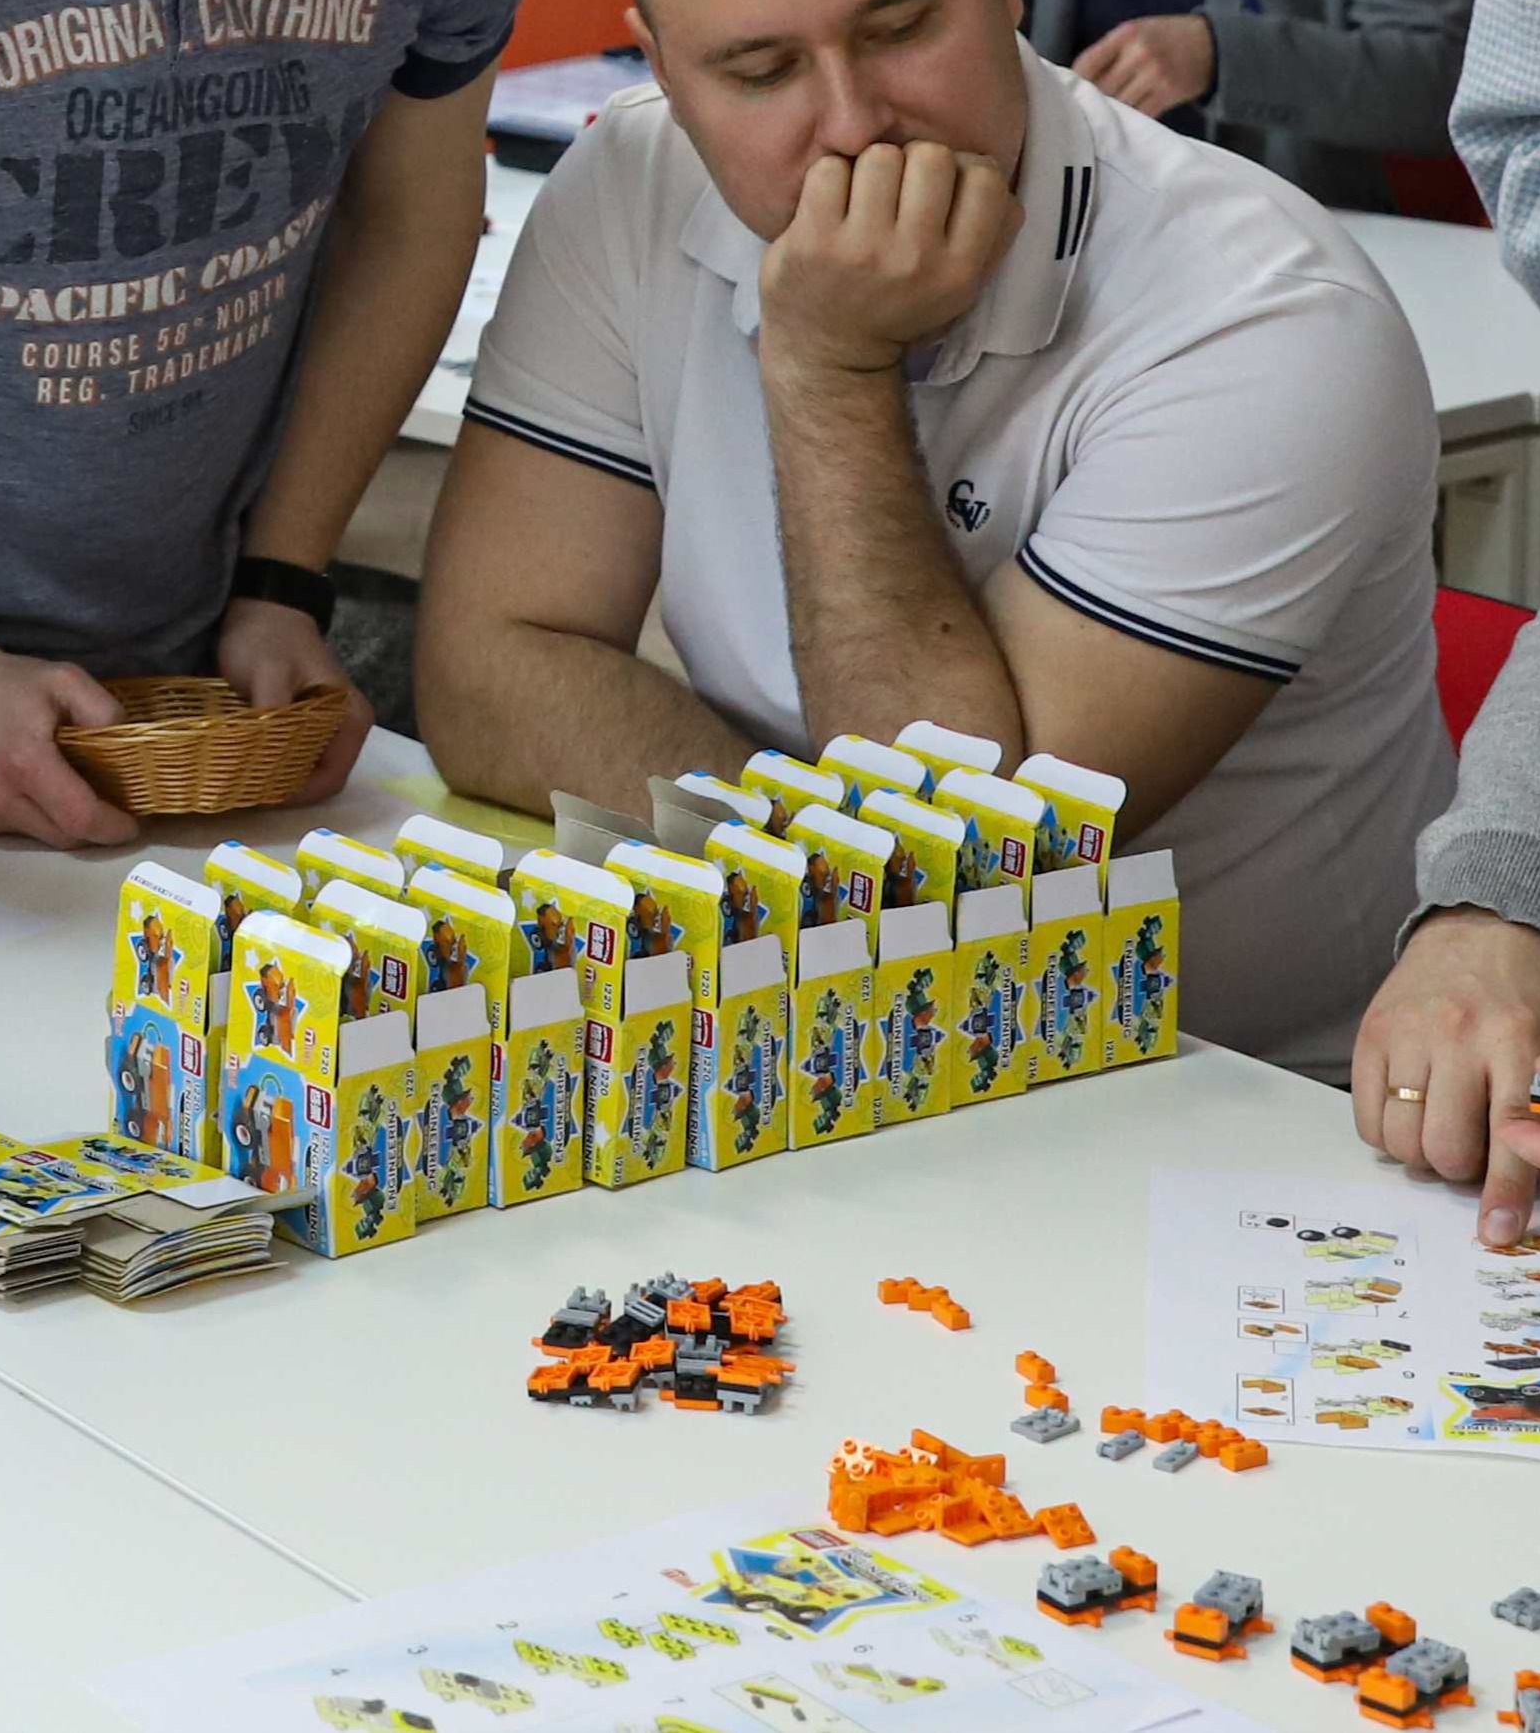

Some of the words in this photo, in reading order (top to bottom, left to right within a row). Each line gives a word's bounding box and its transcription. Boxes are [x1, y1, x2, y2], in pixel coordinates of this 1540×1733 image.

[66, 58, 311, 143] OCEANGOING
[200, 197, 332, 290] COAST
[21, 333, 140, 369] COURSE
[216, 272, 286, 331] NORTH
[36, 375, 107, 404] REG.
[127, 314, 273, 395] TRADEMARK
[603, 982, 613, 1011] 1220
[701, 969, 711, 998] 1220
[862, 975, 870, 1002] 1220
[1020, 938, 1029, 966] 1220
[1123, 939, 1134, 1039] ENGINEERING
[192, 995, 202, 1025] 1220
[892, 993, 903, 1096] ENGINEERING
[1001, 966, 1011, 1068] ENGINEERING
[1046, 953, 1058, 1055] ENGINEERING
[320, 1046, 331, 1075] 1220
[600, 1068, 610, 1097] 1220
[632, 1046, 646, 1154] ENGINEERING
[687, 1050, 700, 1157] ENGINEERING
[702, 1054, 711, 1083] 1220
[762, 1020, 772, 1127] ENGINEERING
[844, 1004, 854, 1108] ENGINEERING
[182, 1079, 193, 1159] ENGINEER
[387, 1100, 398, 1212] ENGINEERING
[428, 1082, 440, 1191] ENGINEERING
[554, 1056, 566, 1164] ENGINEERING
[584, 1064, 599, 1171] ENGINEERING
[309, 1131, 320, 1243] ENGINRING
